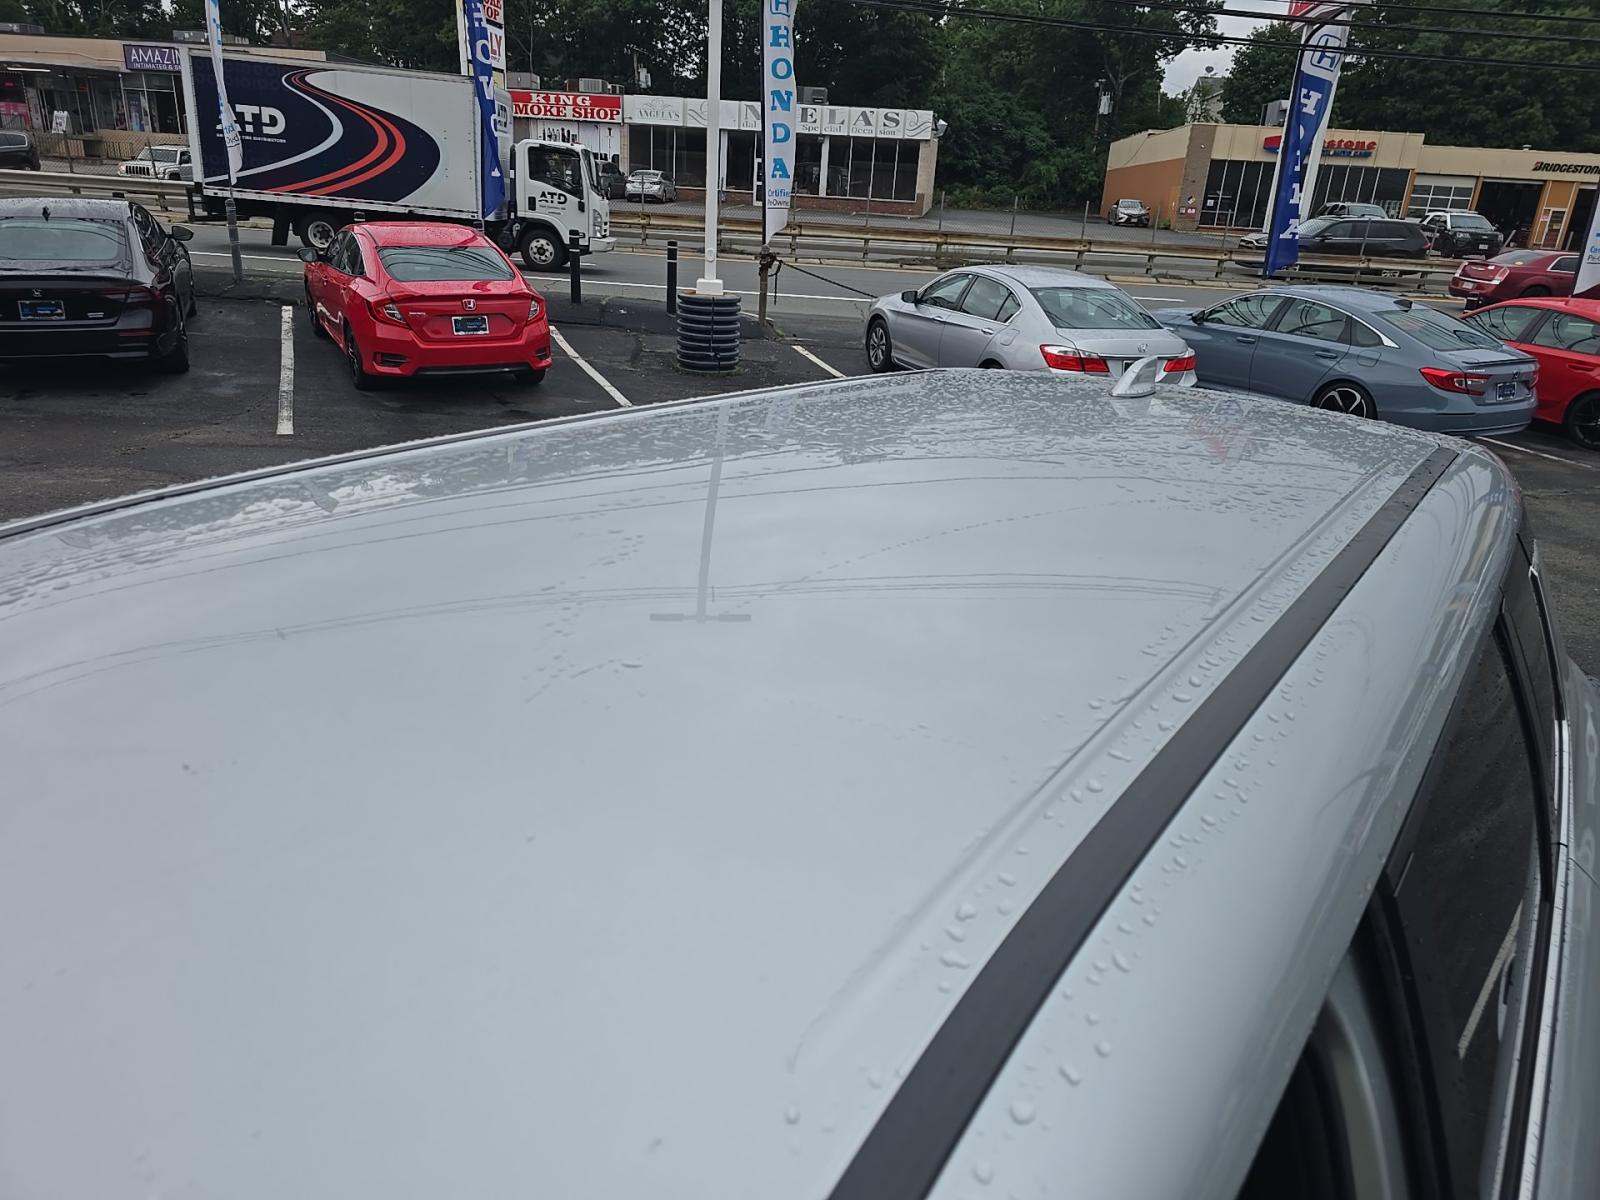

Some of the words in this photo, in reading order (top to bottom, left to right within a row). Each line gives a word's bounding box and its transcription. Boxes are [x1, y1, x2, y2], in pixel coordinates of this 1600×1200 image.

[131, 47, 181, 64] AMAZIN
[530, 93, 592, 106] KING
[770, 26, 793, 178] HONDA
[513, 103, 567, 118] MOKE
[572, 107, 621, 120] SHOP
[1532, 160, 1600, 174] BRIDGESTON
[538, 191, 567, 204] ATD
